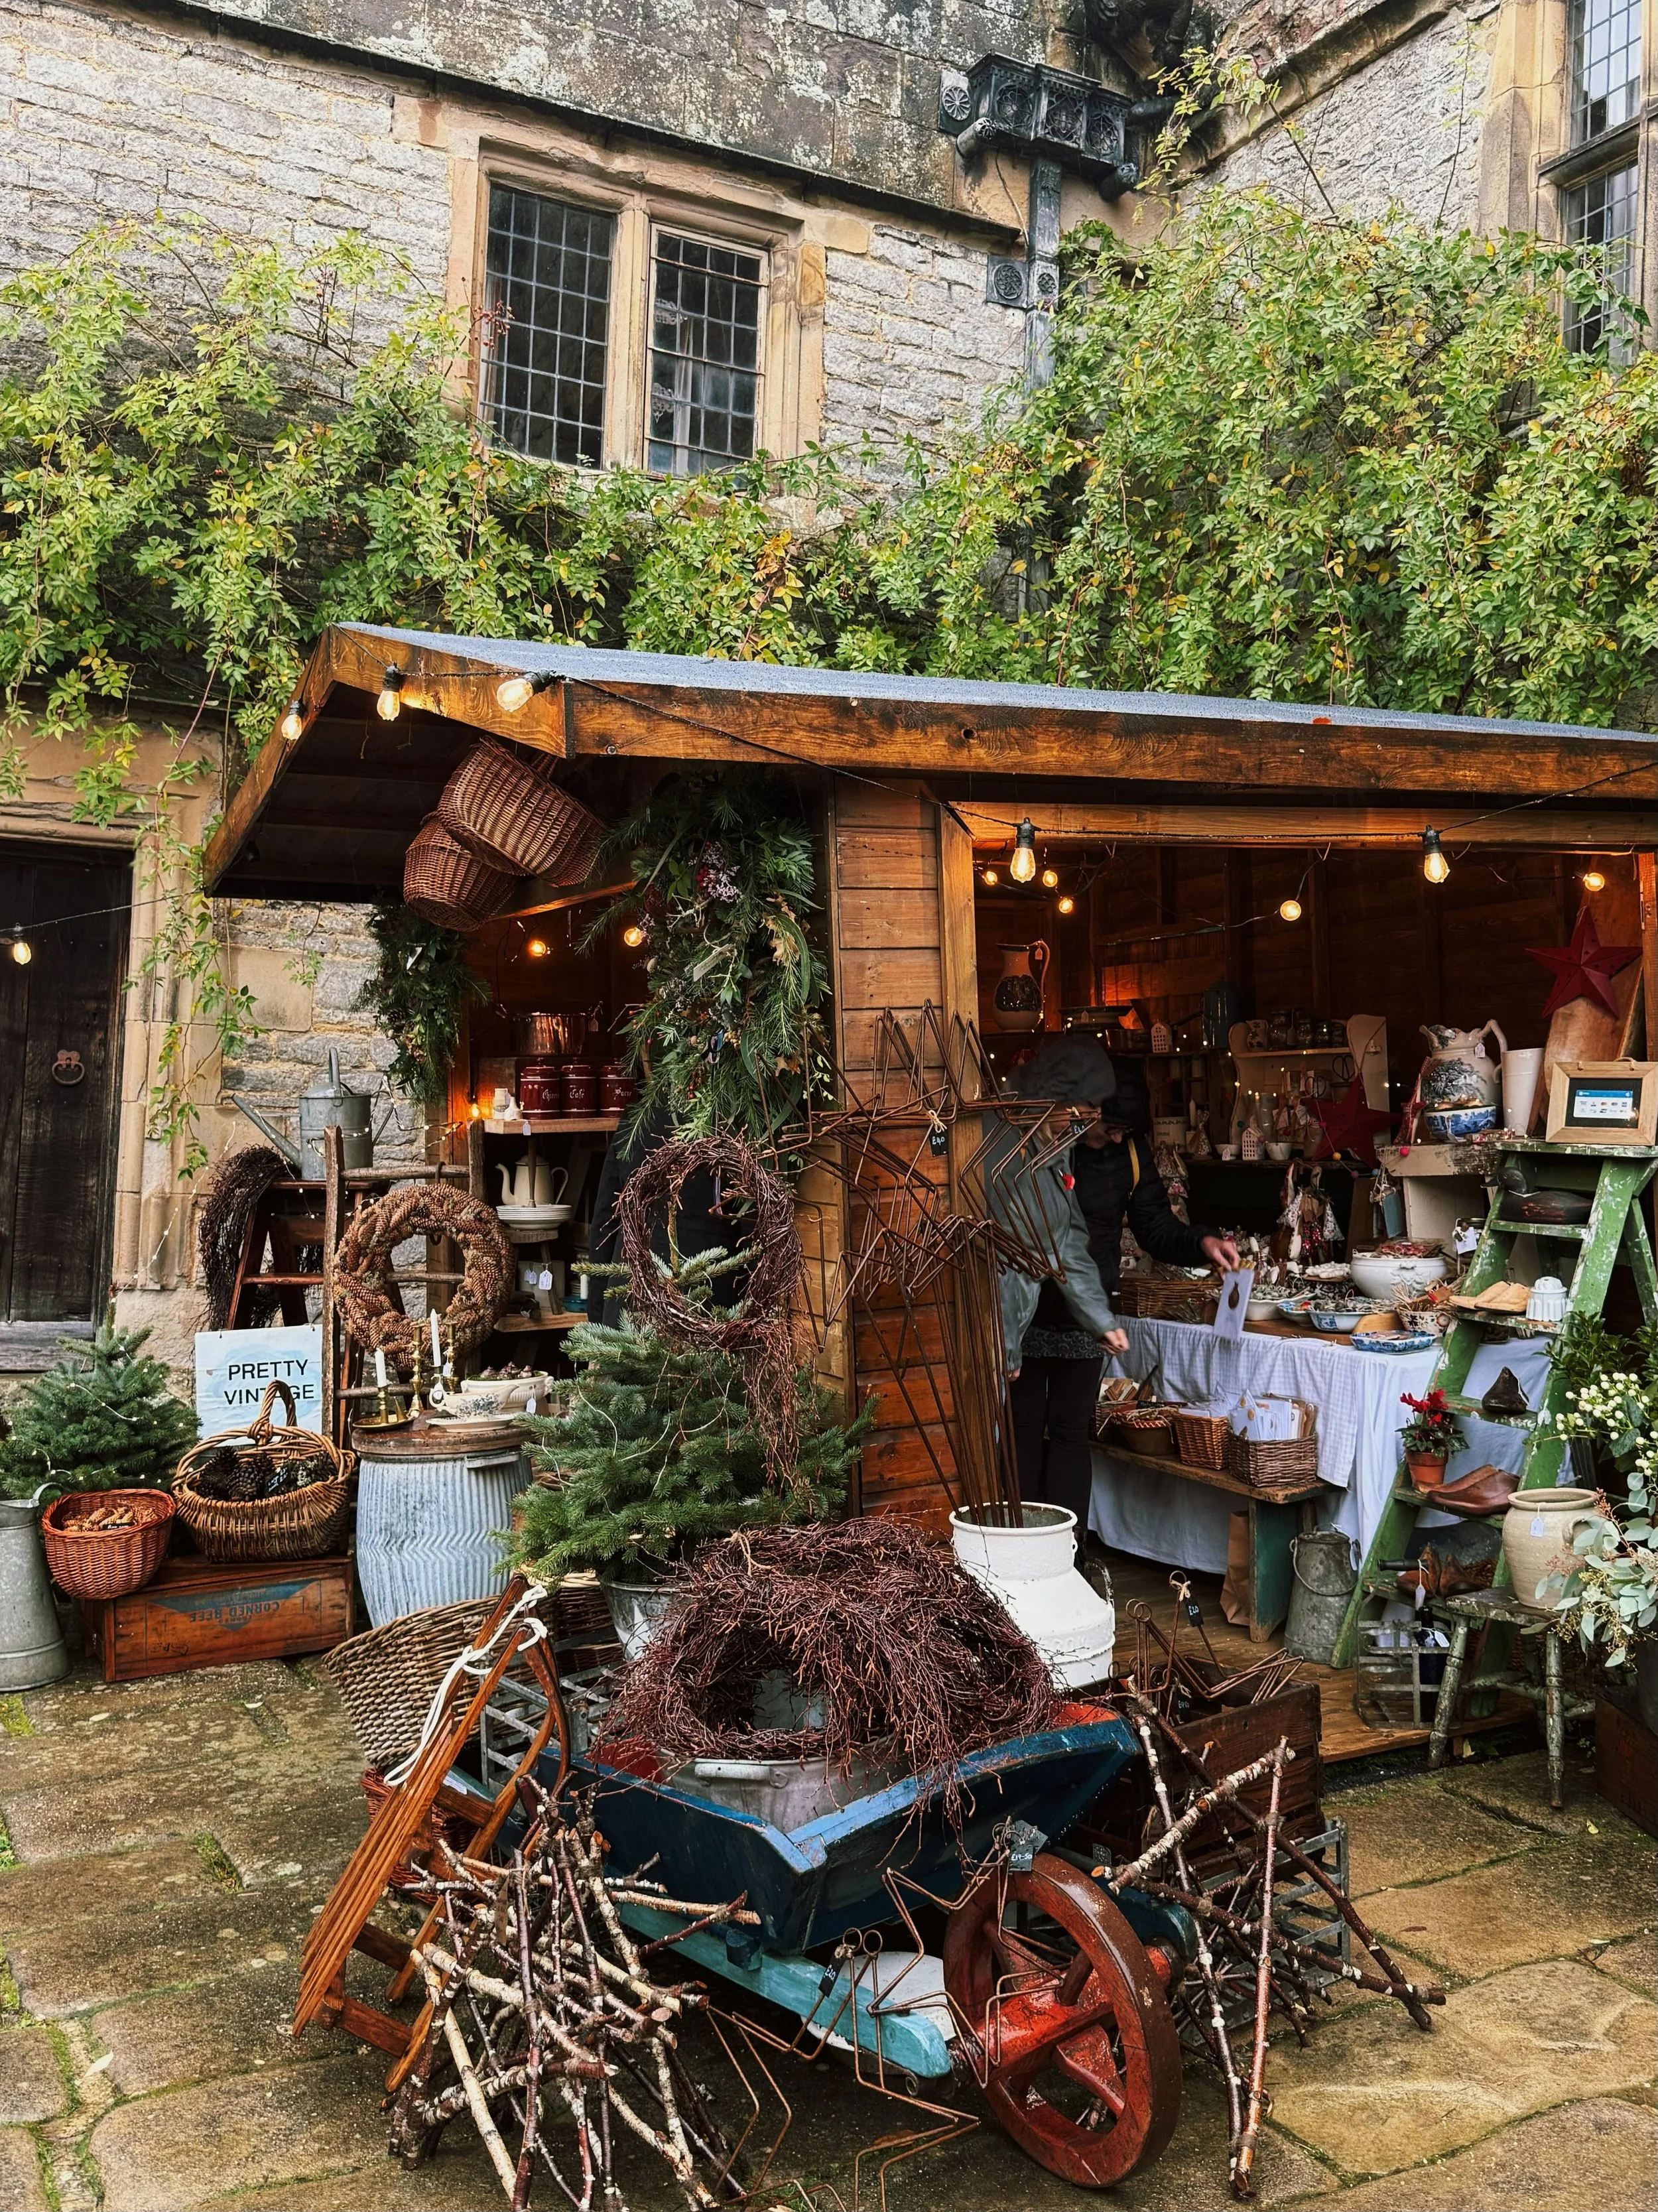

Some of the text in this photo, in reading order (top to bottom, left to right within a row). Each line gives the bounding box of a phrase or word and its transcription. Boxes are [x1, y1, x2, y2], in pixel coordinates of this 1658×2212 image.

[229, 1359, 308, 1380] PRETTY
[224, 1384, 314, 1405] VINGE
[190, 1600, 279, 1622] CORNED BEEF
